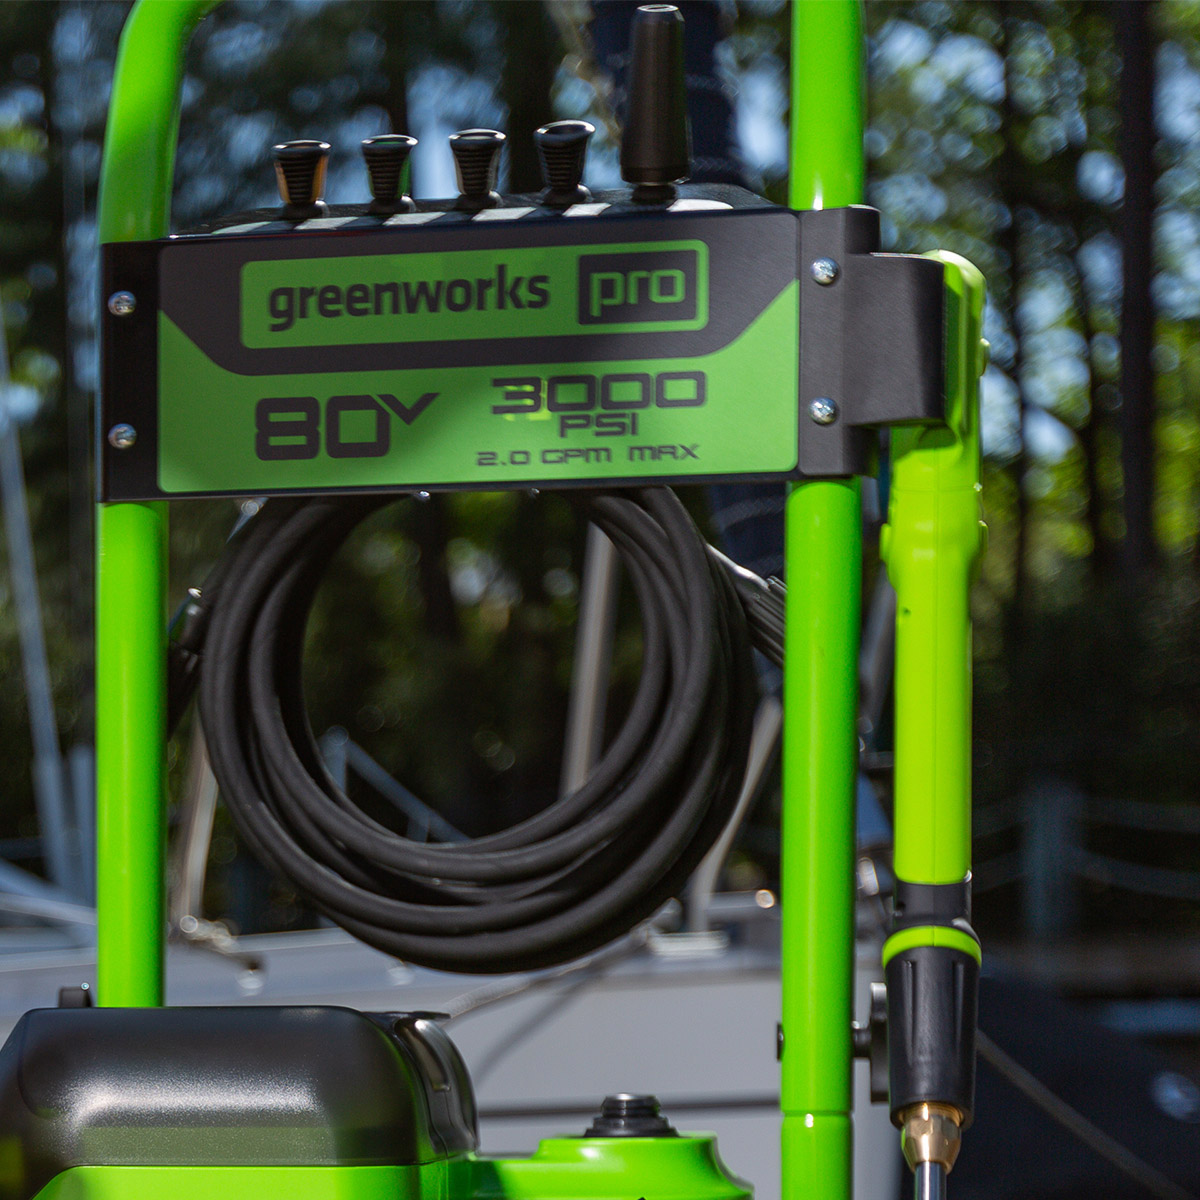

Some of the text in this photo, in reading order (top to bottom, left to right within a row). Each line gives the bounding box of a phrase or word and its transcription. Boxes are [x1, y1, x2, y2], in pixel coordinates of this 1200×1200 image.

[269, 264, 686, 332] greenworks pro
[492, 371, 706, 415] 3000
[559, 413, 638, 438] PSI
[476, 443, 699, 467] 2.0 GPM MAX
